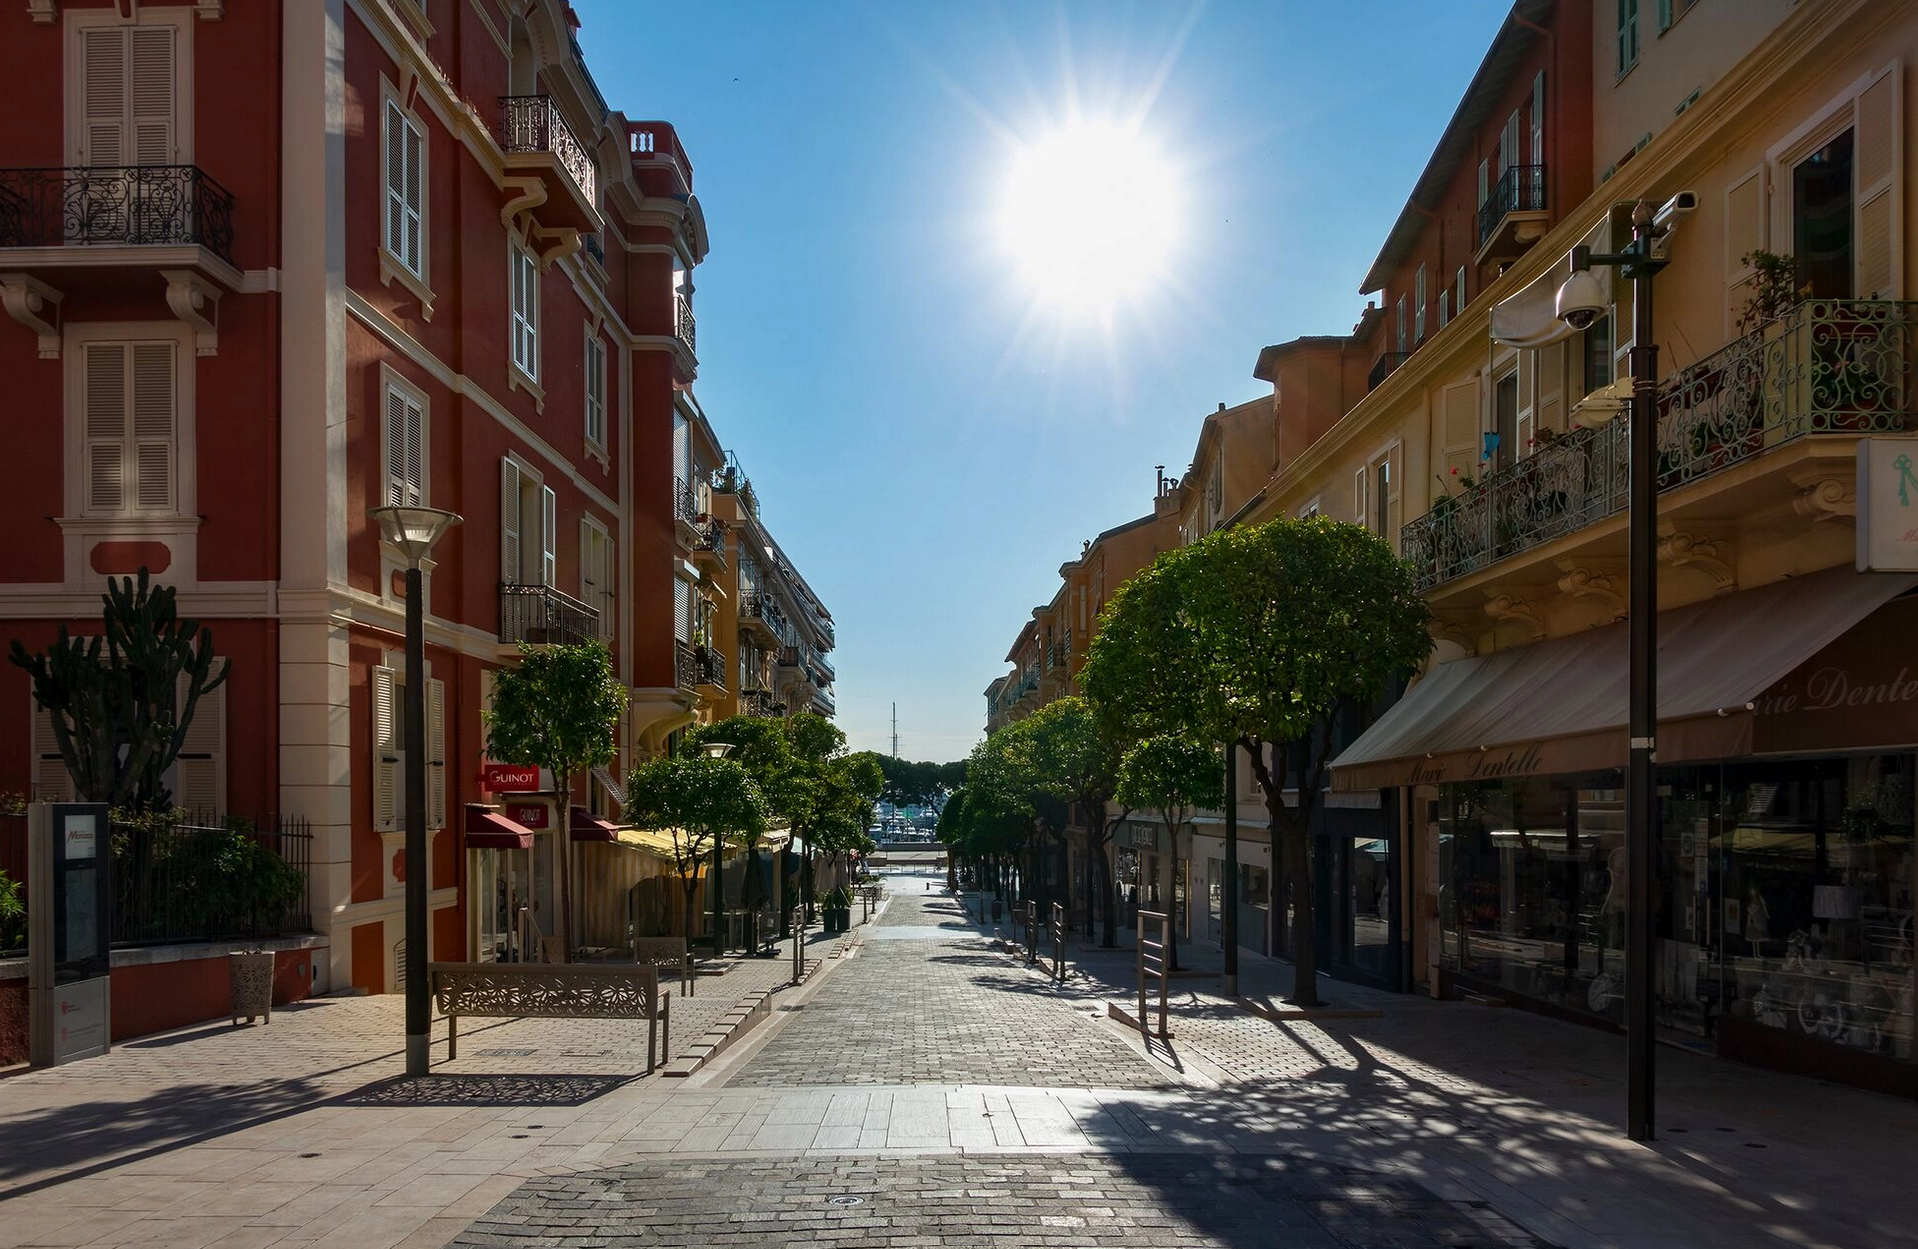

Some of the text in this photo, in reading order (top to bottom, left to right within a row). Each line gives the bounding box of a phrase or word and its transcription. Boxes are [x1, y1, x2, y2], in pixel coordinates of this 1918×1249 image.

[1802, 667, 1918, 711] Dente
[489, 770, 534, 783] GUINOT
[1405, 743, 1544, 783] Marie Dentelle
